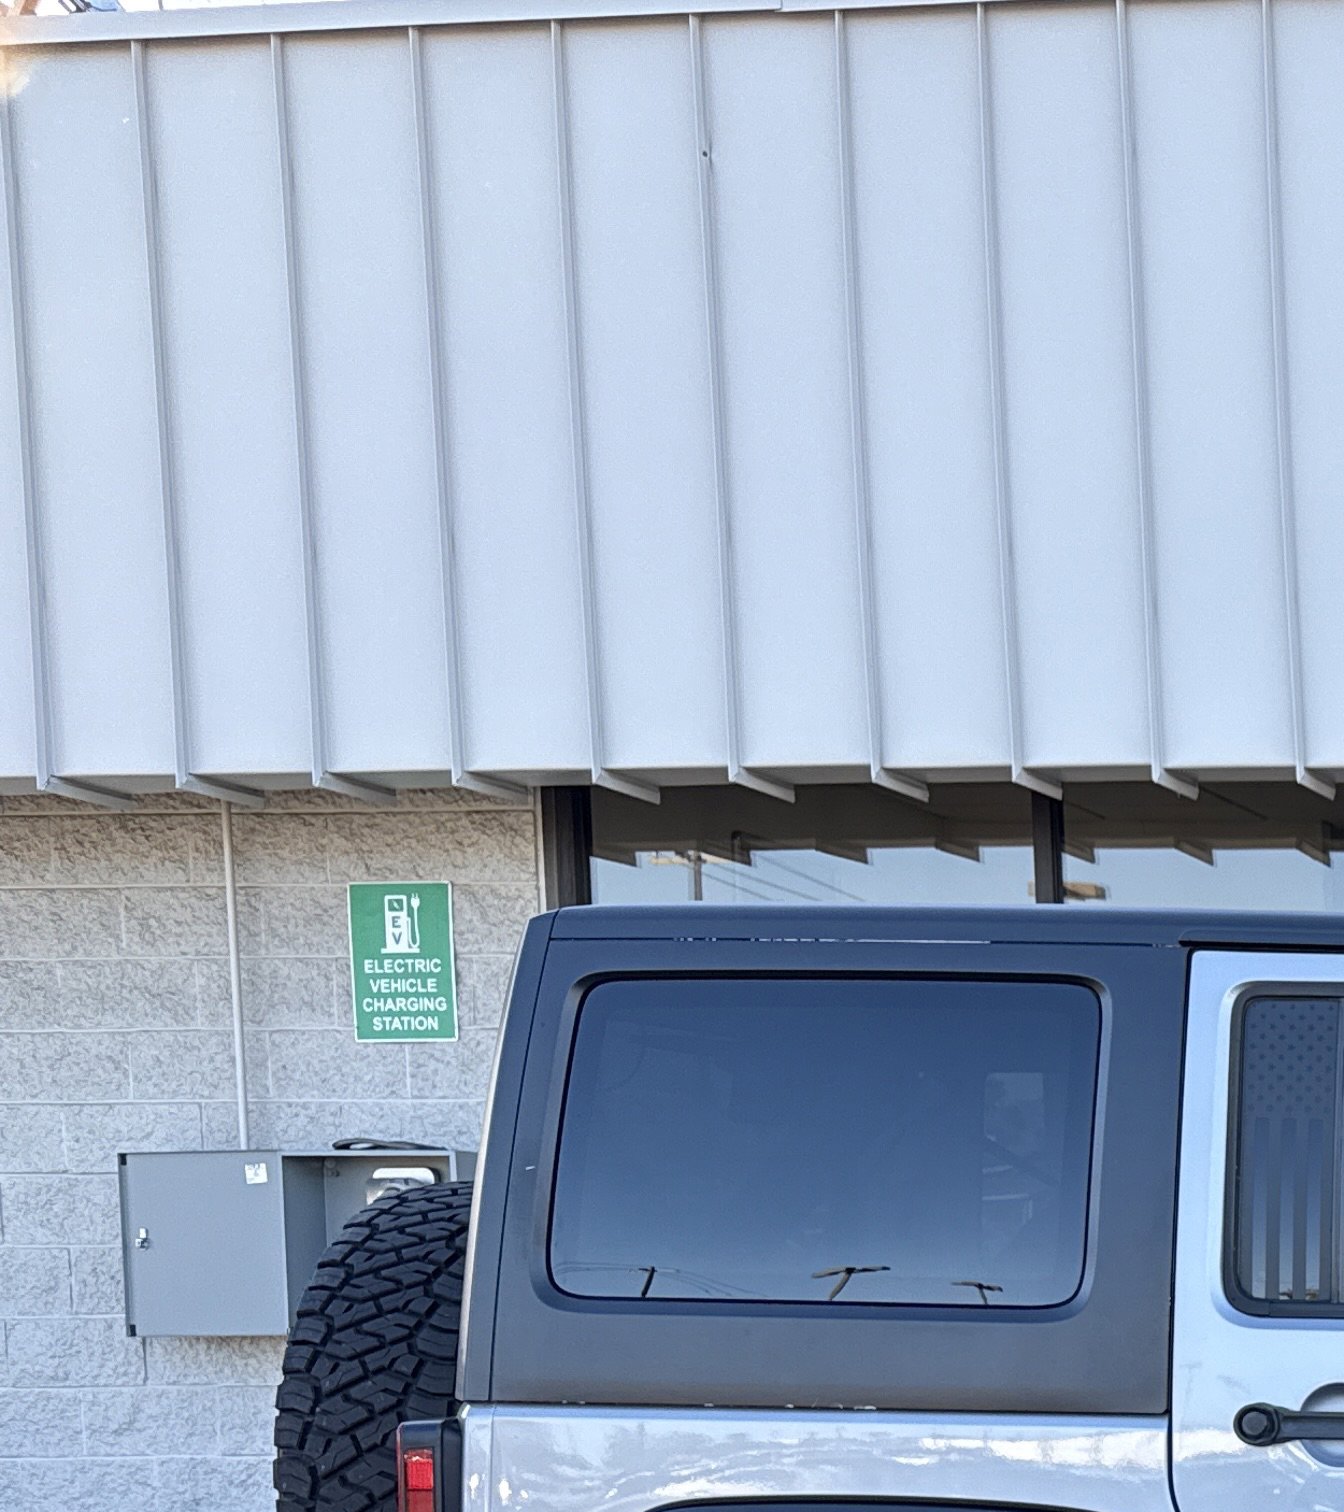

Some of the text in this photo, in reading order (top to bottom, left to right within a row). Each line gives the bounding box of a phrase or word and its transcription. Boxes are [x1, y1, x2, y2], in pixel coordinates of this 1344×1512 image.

[363, 958, 442, 974] ELECTRIC
[369, 978, 438, 993] VEHICLE
[362, 997, 448, 1012] CHARGING
[372, 1015, 439, 1031] STATION
